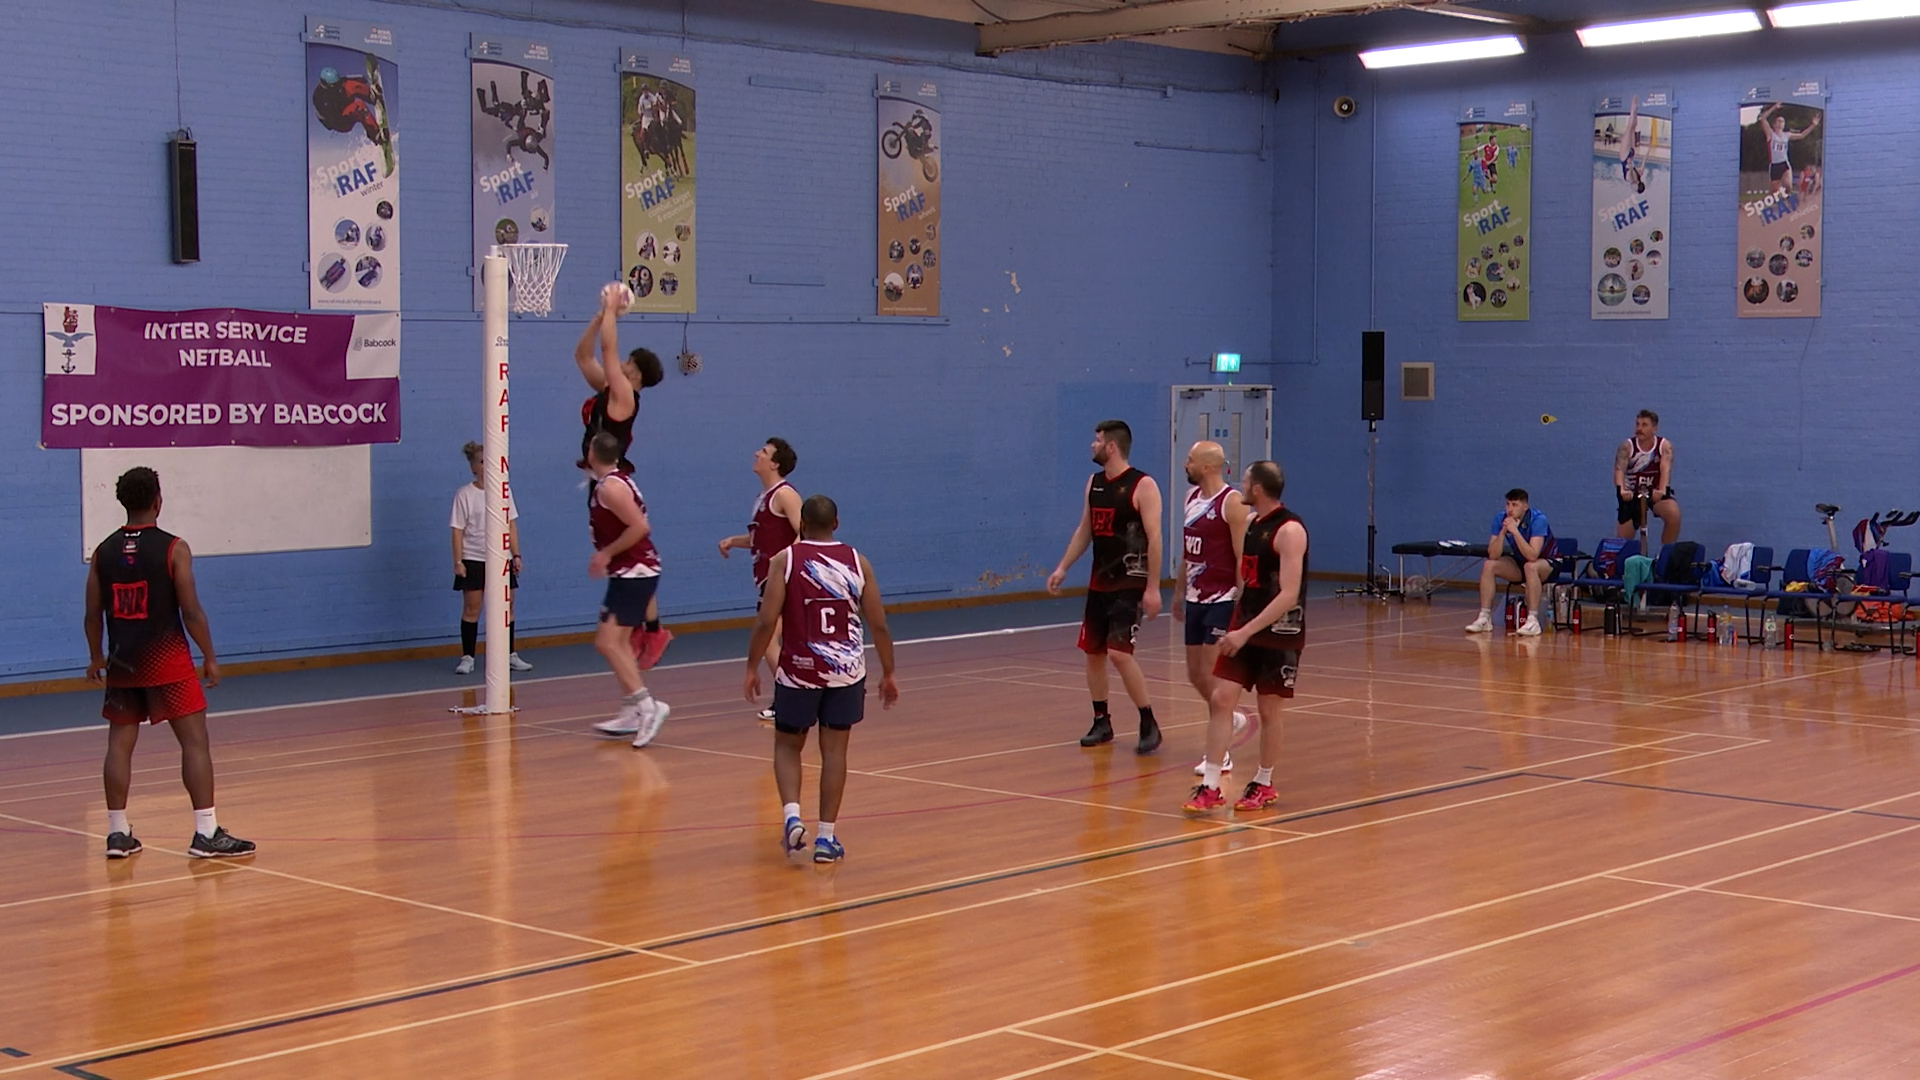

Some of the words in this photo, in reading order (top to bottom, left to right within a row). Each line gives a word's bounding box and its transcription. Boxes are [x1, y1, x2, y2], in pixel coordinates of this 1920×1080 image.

[336, 161, 377, 196] RAF
[360, 180, 384, 198] winter
[480, 160, 523, 193] Sport
[498, 171, 535, 204] RAF
[625, 168, 665, 199] Sport
[642, 177, 676, 210] RAF
[884, 184, 918, 213] Sport
[897, 192, 926, 222] RAF
[1599, 194, 1638, 222] Sport
[1744, 186, 1789, 217] Sport
[918, 205, 936, 220] wheels
[1463, 199, 1501, 228] Sport
[1478, 206, 1511, 235] RAF
[1614, 200, 1649, 230] RAF
[1789, 204, 1820, 222] athletics
[144, 321, 211, 340] INTER
[216, 321, 308, 344] SERVICE
[364, 338, 396, 348] Babcock
[178, 348, 272, 368] NETBALL
[51, 403, 222, 426] SPONSORED
[229, 403, 268, 425] BY
[274, 402, 387, 425] BABCOCK
[820, 607, 836, 634] C
